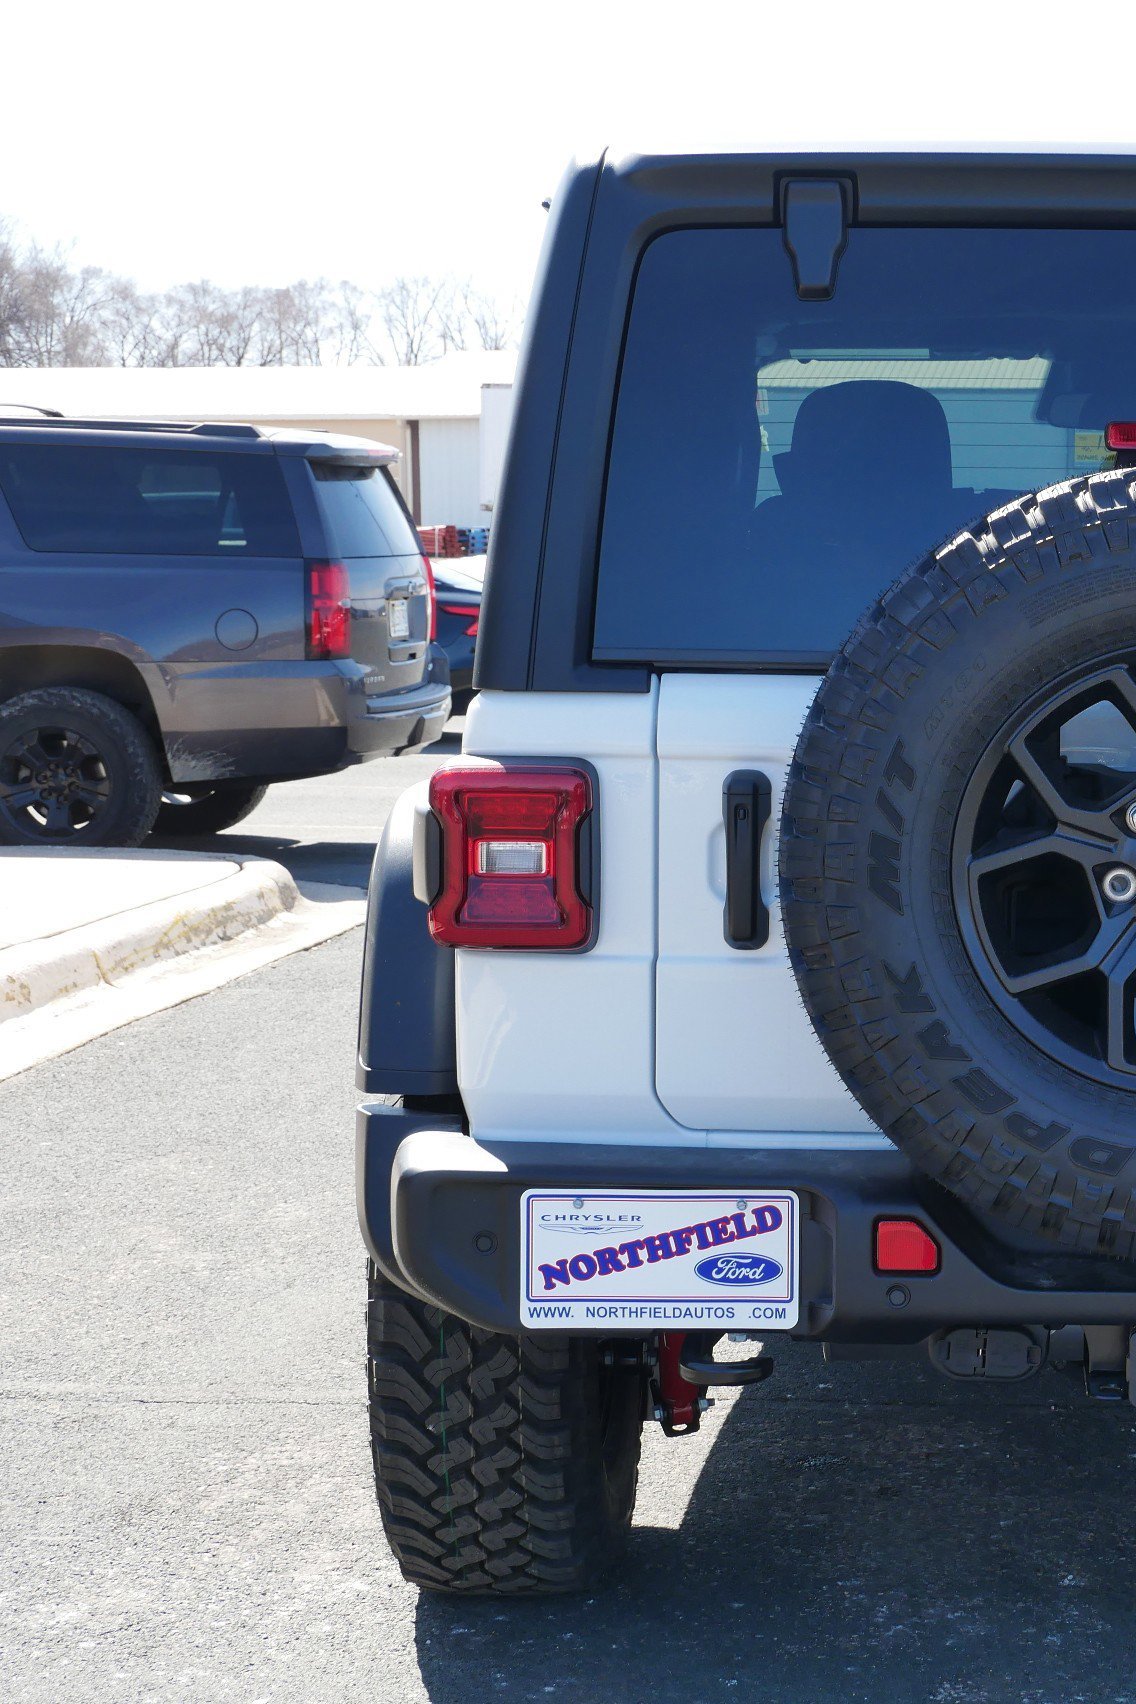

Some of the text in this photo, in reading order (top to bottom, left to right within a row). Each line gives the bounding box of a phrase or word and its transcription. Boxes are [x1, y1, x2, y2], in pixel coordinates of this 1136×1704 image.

[868, 740, 920, 915] M/T
[541, 1214, 642, 1222] CHRYSLER
[538, 1204, 783, 1290] NORTHFIELD
[711, 1257, 764, 1280] Ford
[528, 1306, 786, 1319] WWW. NORTHFIELDAUTOS .COM
